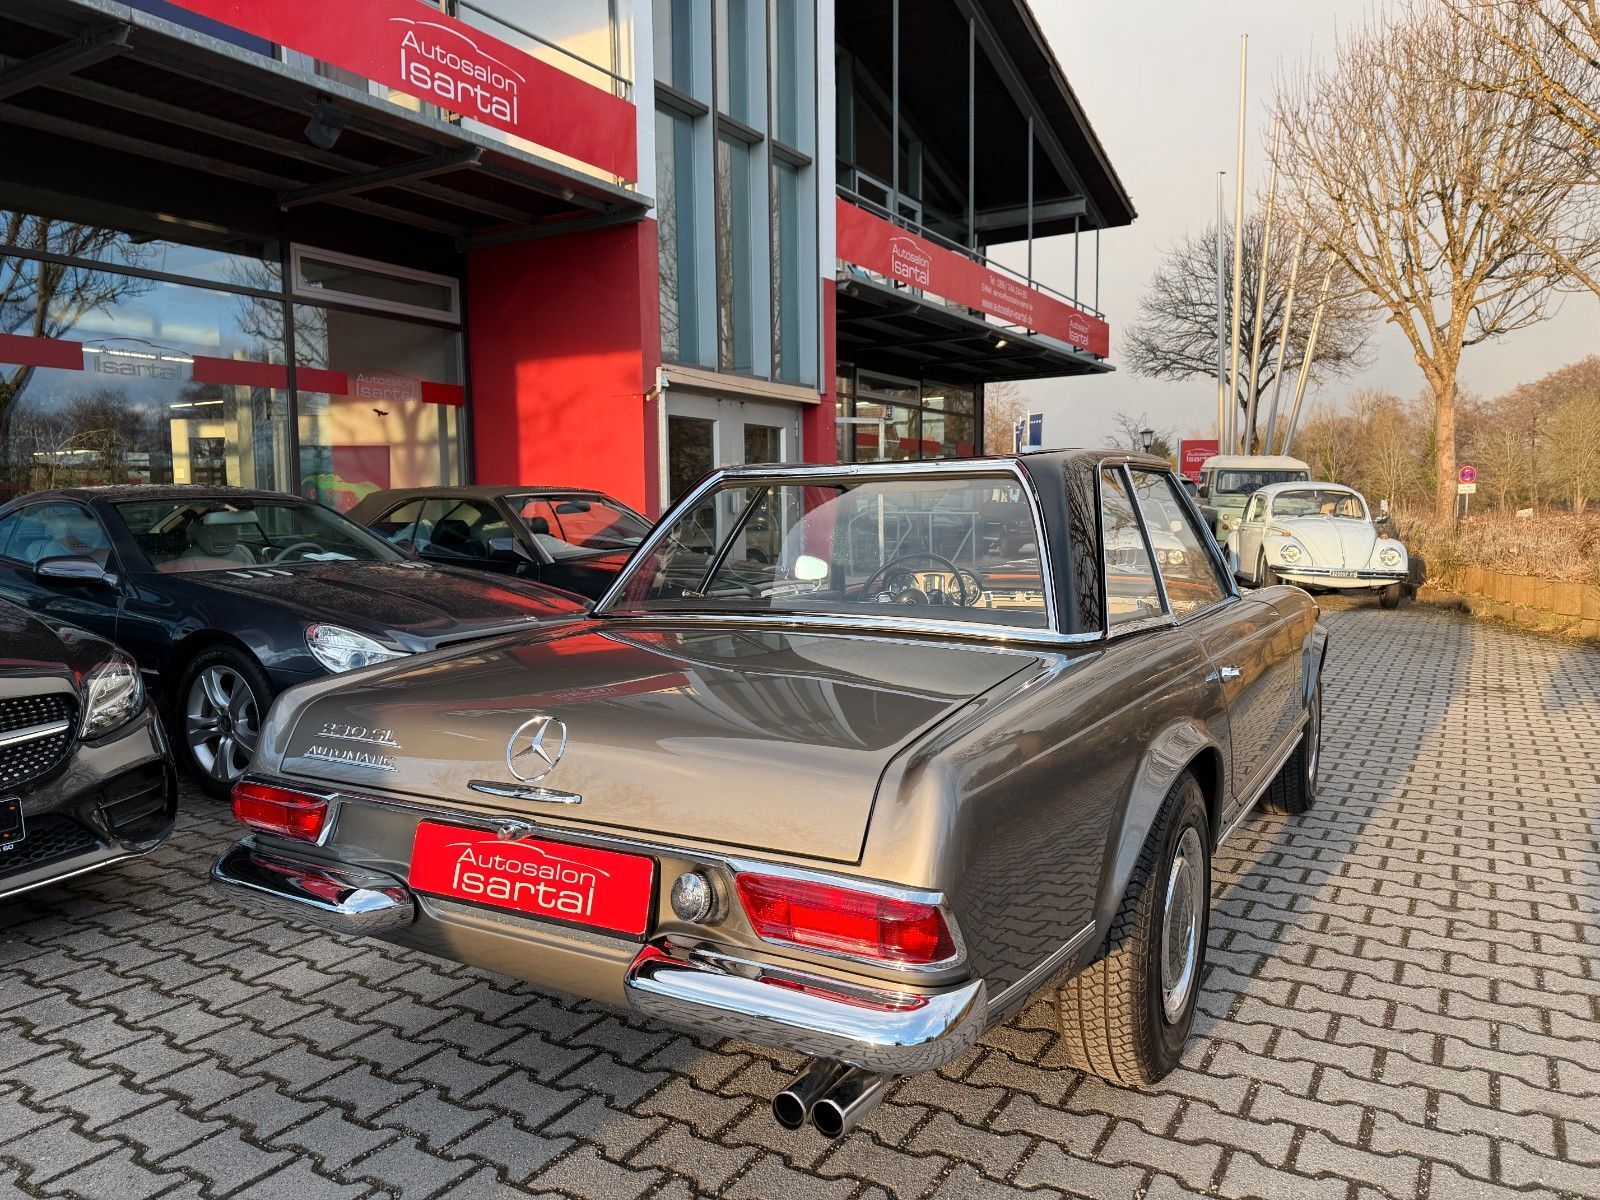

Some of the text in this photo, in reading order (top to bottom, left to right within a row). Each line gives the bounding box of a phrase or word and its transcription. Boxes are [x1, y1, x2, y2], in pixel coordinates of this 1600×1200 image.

[401, 30, 517, 96] Autosalon
[400, 48, 518, 125] Isartal
[892, 243, 929, 268] Autosalon
[891, 254, 929, 286] Isartal
[94, 356, 183, 381] Isartal
[356, 373, 415, 388] Autosalon
[356, 382, 415, 401] Isartal
[306, 745, 397, 769] AUTOMATIC
[456, 847, 596, 888] Autosalon
[452, 862, 595, 916] Isartal
